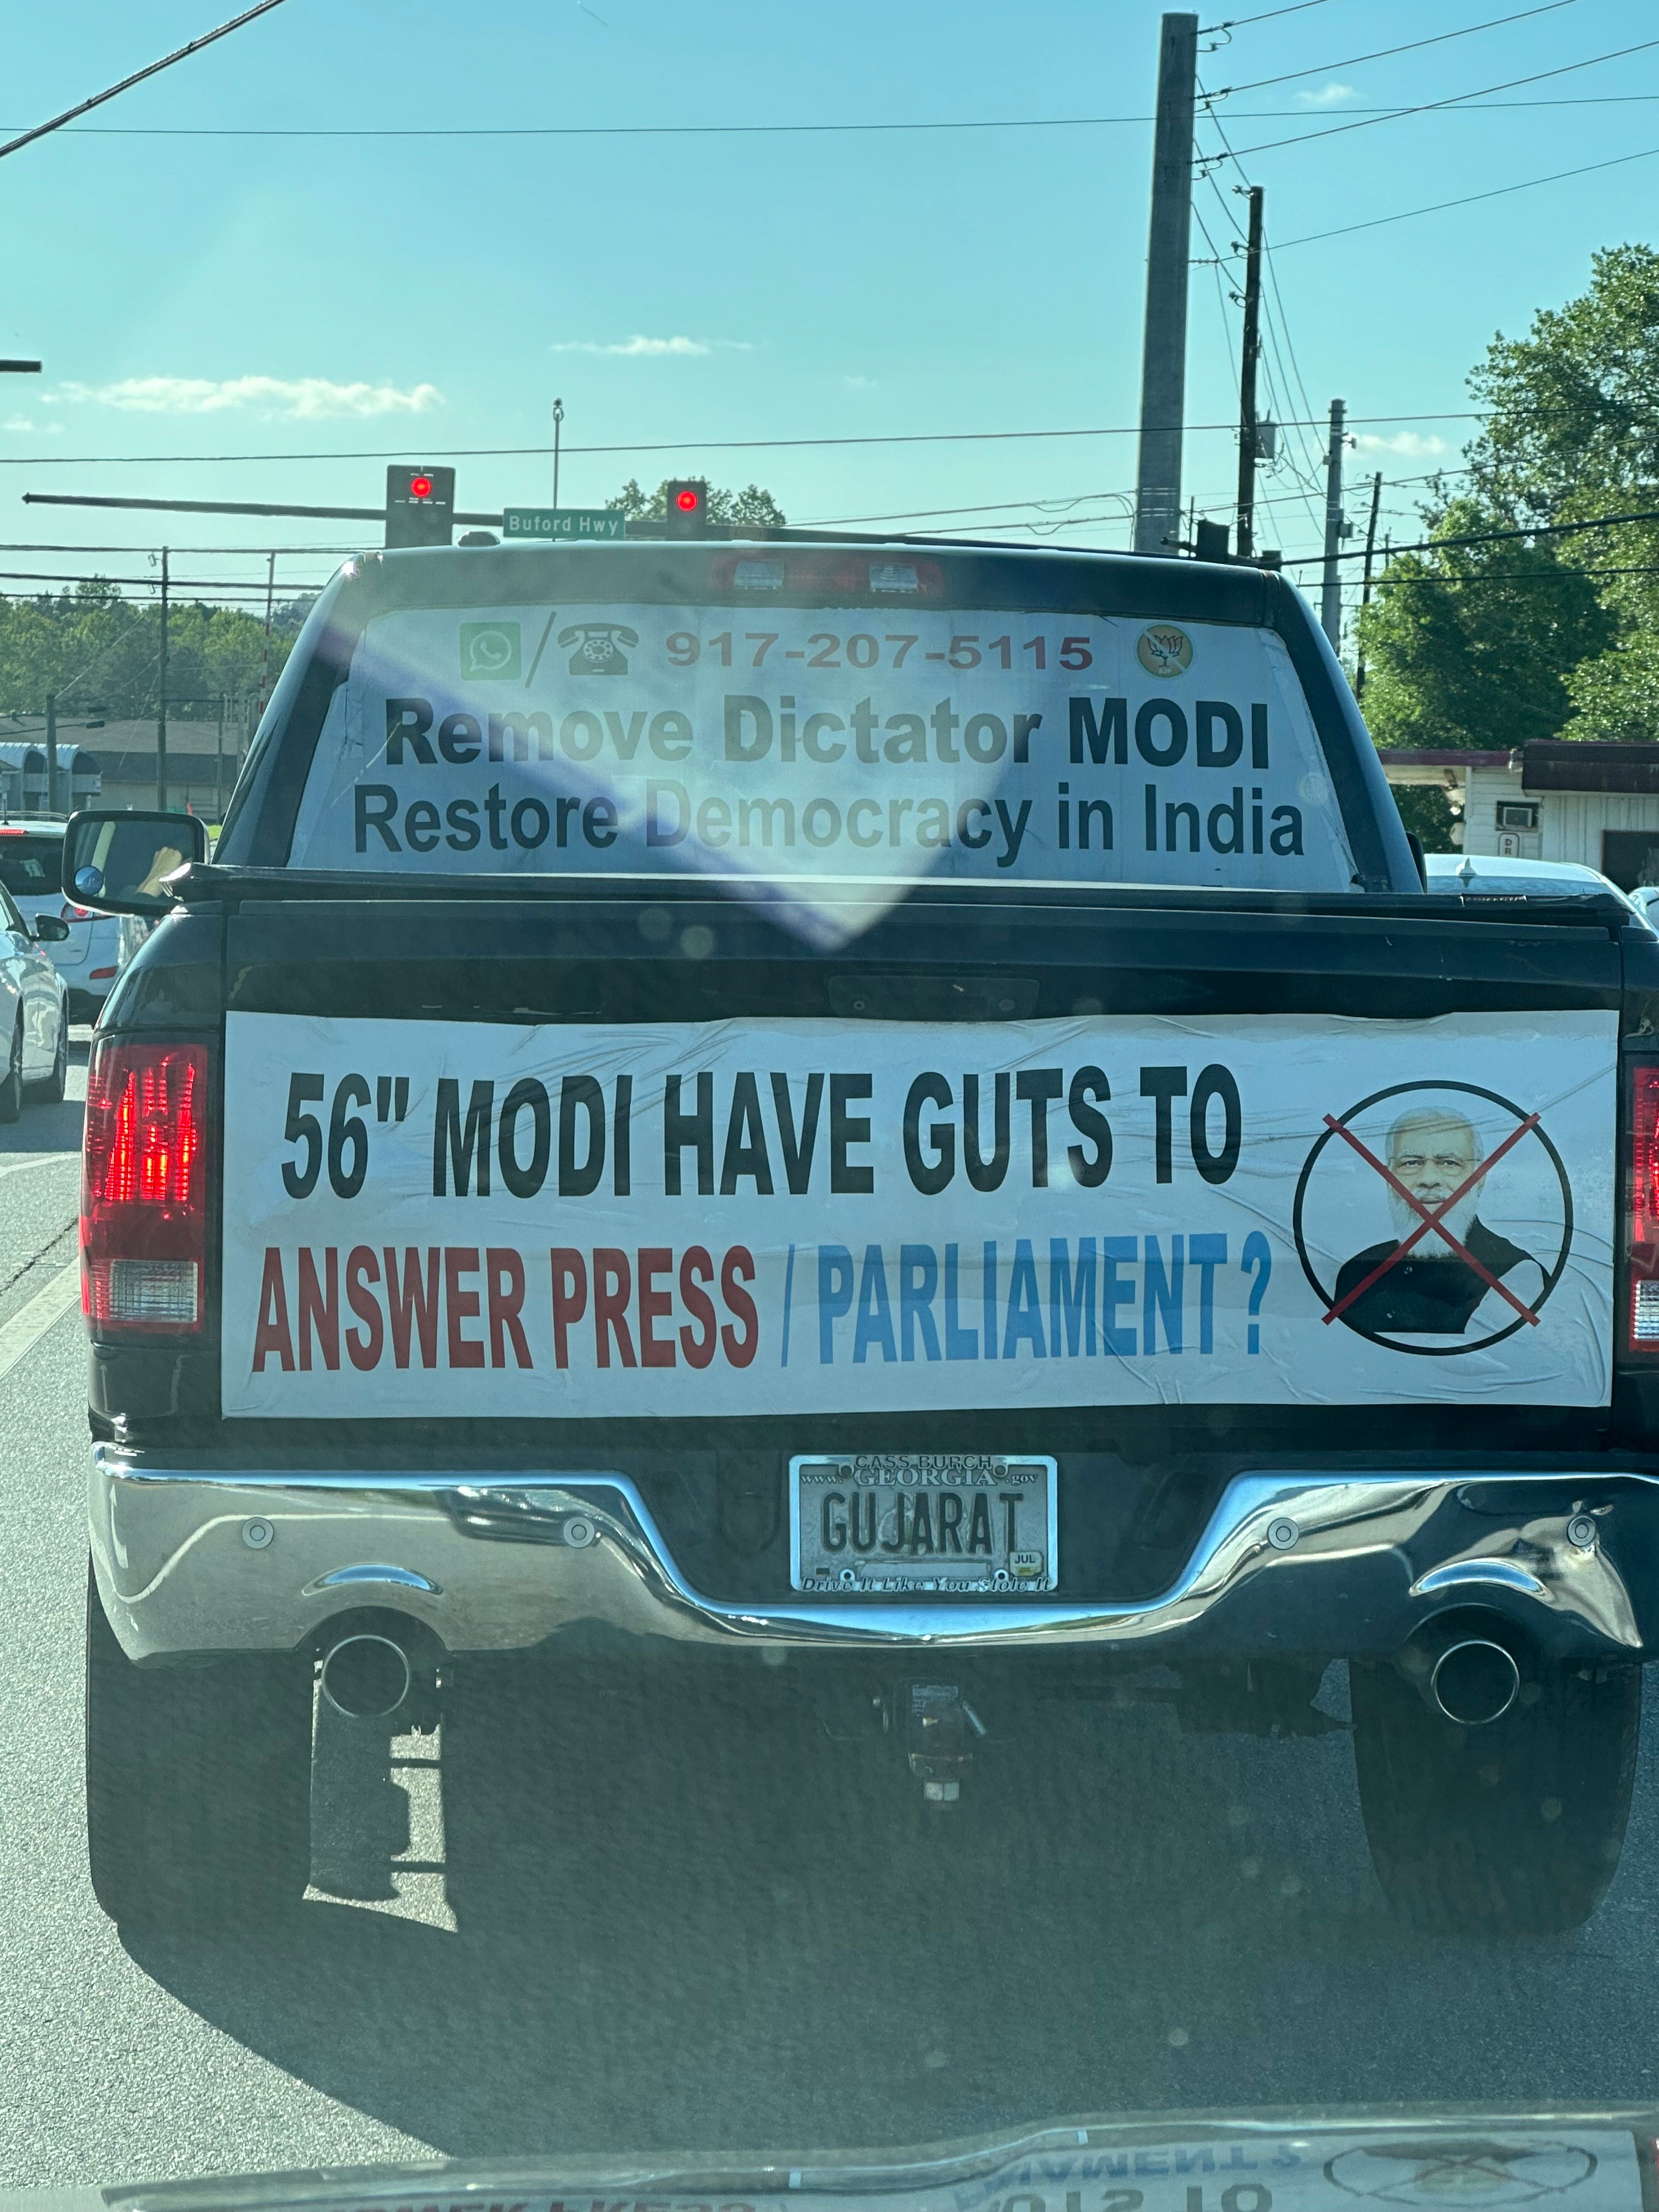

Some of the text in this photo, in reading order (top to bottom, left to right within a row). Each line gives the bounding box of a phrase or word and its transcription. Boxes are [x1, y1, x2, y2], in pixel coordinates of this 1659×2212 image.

[509, 516, 618, 536] Buford Hwy
[665, 631, 1093, 670] 917-207-5115
[386, 694, 1269, 769] Remove Dictator MODI
[354, 779, 1304, 868] Restore Democracy in India
[280, 1063, 1242, 1199] 56" MODI HAVE GUTS TO
[252, 1245, 534, 1372] ANSWER
[550, 1245, 759, 1369] PRESS
[853, 1468, 997, 1487] GEORGIA
[855, 1455, 992, 1469] CASS BURCH
[823, 1491, 1024, 1554] GUJARAT
[1014, 1554, 1036, 1564] JUL
[802, 1577, 1050, 1591] Drive It Like You Stole It
